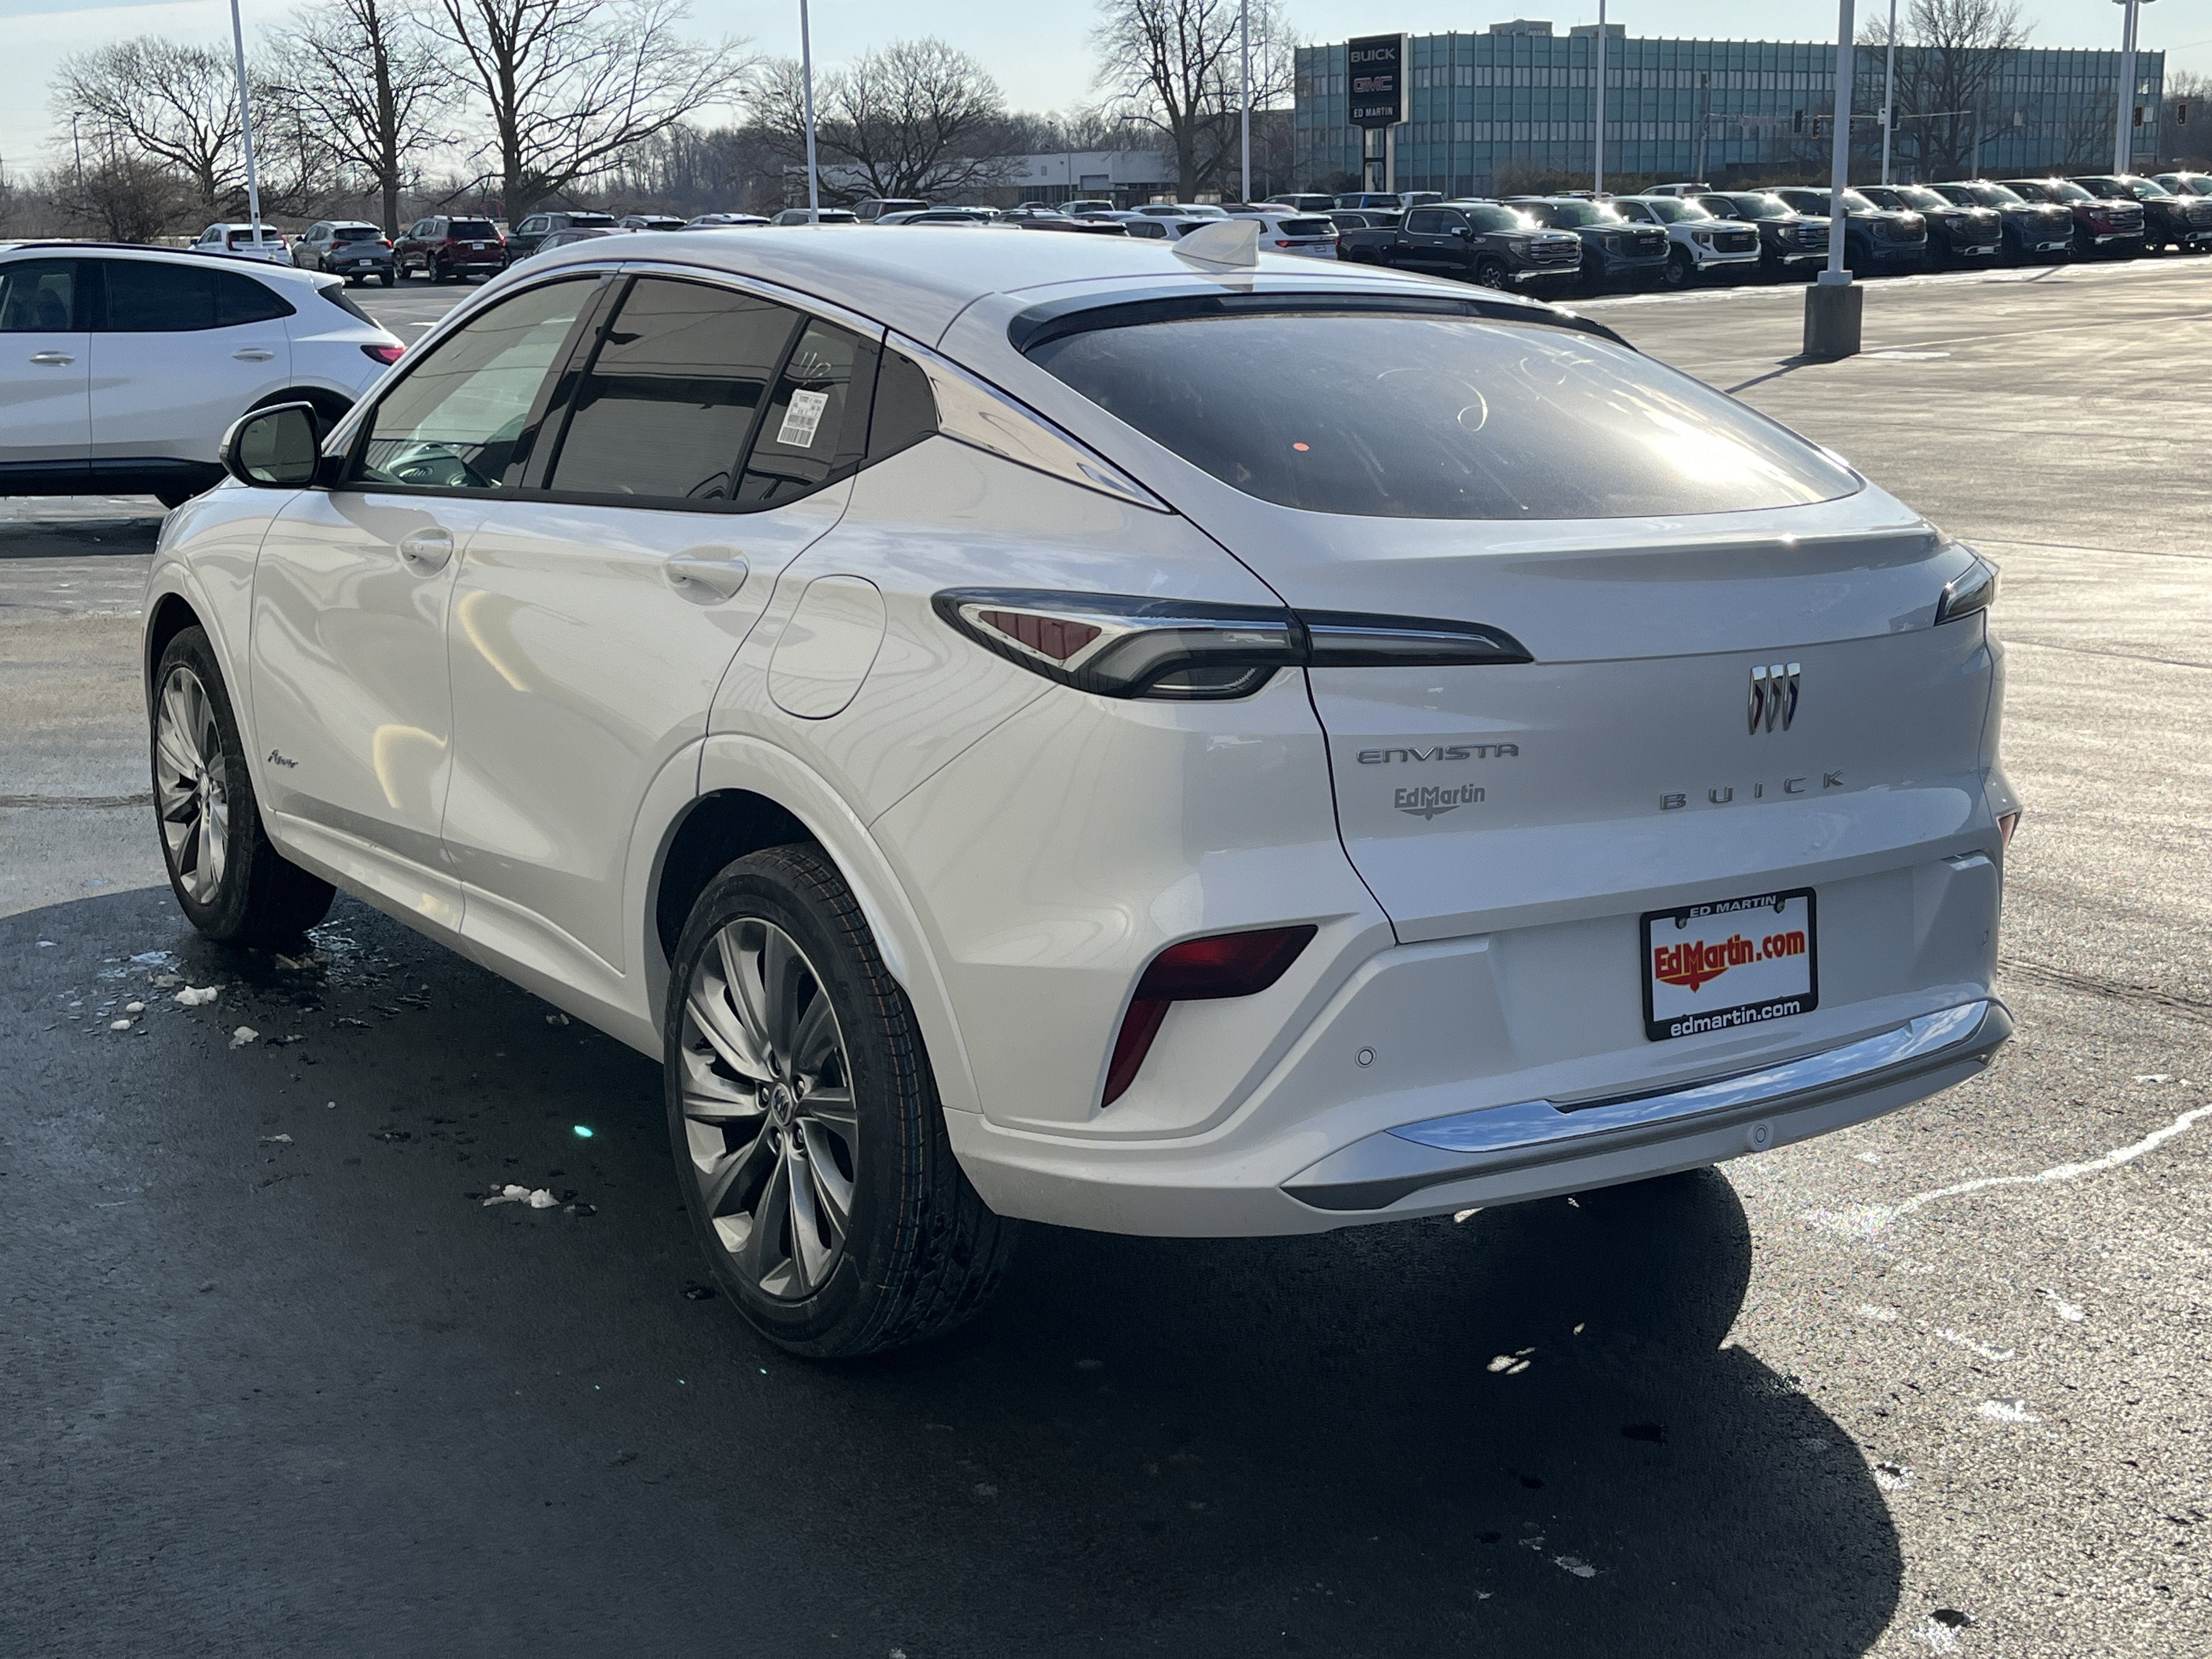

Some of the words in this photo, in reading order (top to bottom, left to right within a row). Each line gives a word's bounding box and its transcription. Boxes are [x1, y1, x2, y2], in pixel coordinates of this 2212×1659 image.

[1350, 48, 1396, 63] BUICK
[1353, 75, 1392, 93] GMC
[1353, 109, 1363, 118] ED
[1365, 106, 1393, 117] MARTIN
[1659, 769, 1844, 810] BUICK
[1689, 906, 1711, 918] ED
[1716, 895, 1777, 914] MARTIN
[1654, 930, 1805, 980] EdMartin.com
[1670, 1000, 1801, 1037] edmartin.com
